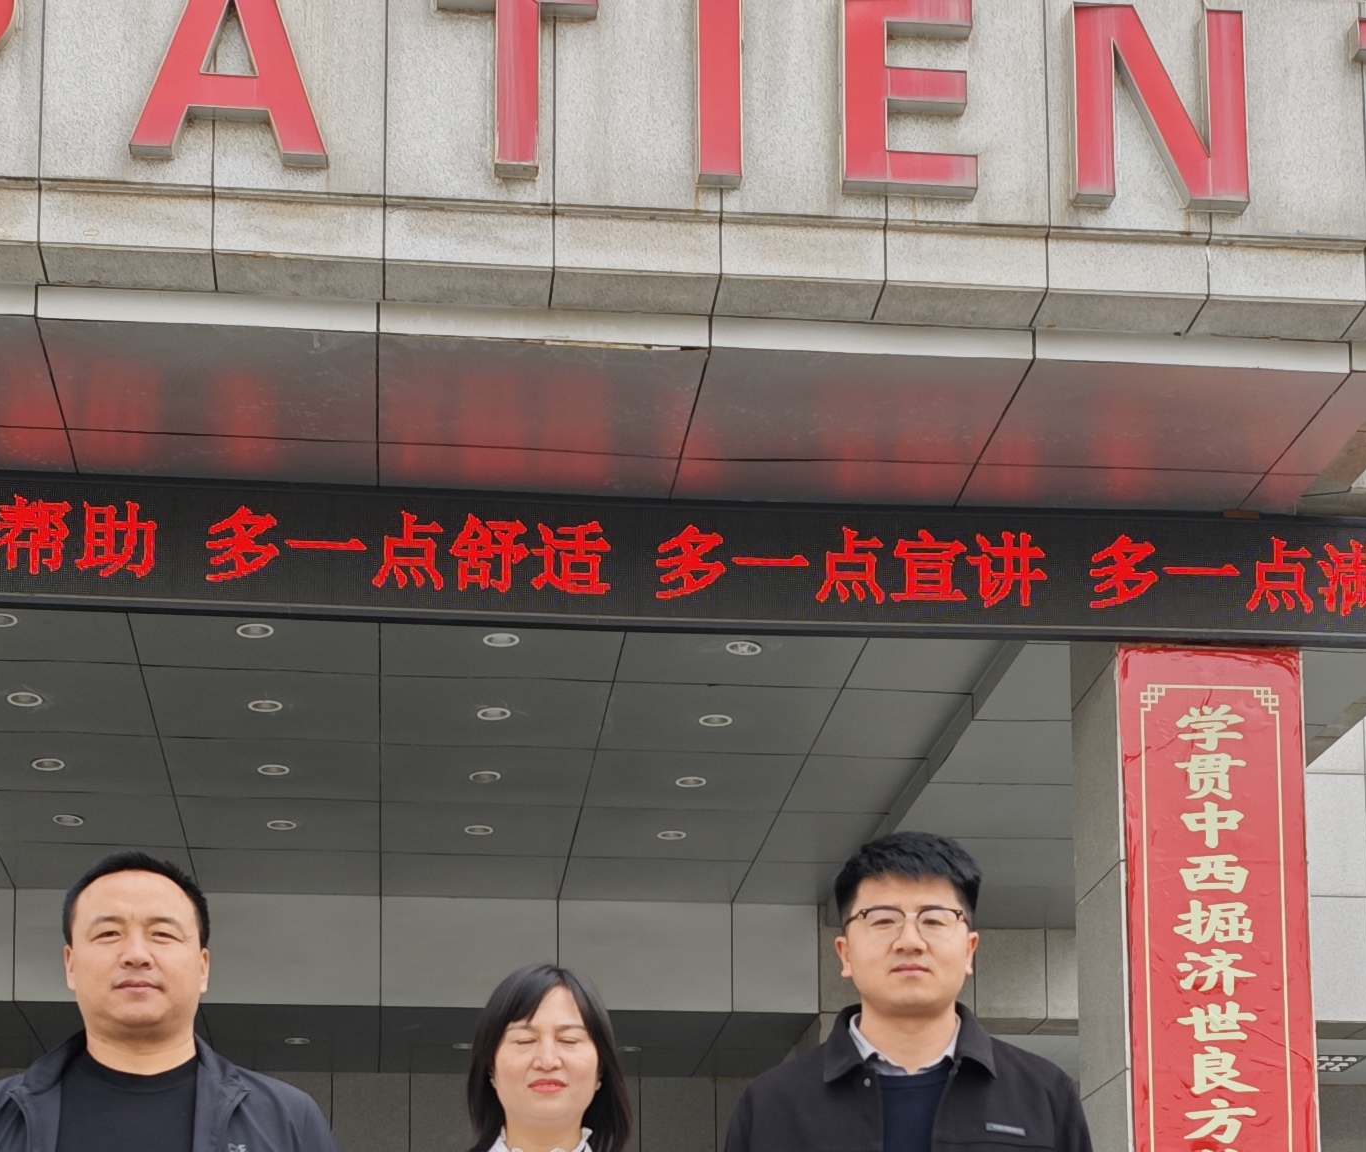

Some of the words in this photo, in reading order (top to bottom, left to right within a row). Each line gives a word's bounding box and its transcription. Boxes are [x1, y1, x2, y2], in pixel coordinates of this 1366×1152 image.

[204, 505, 612, 596] 多一点舒适
[654, 523, 1048, 609] 多一点宣讲
